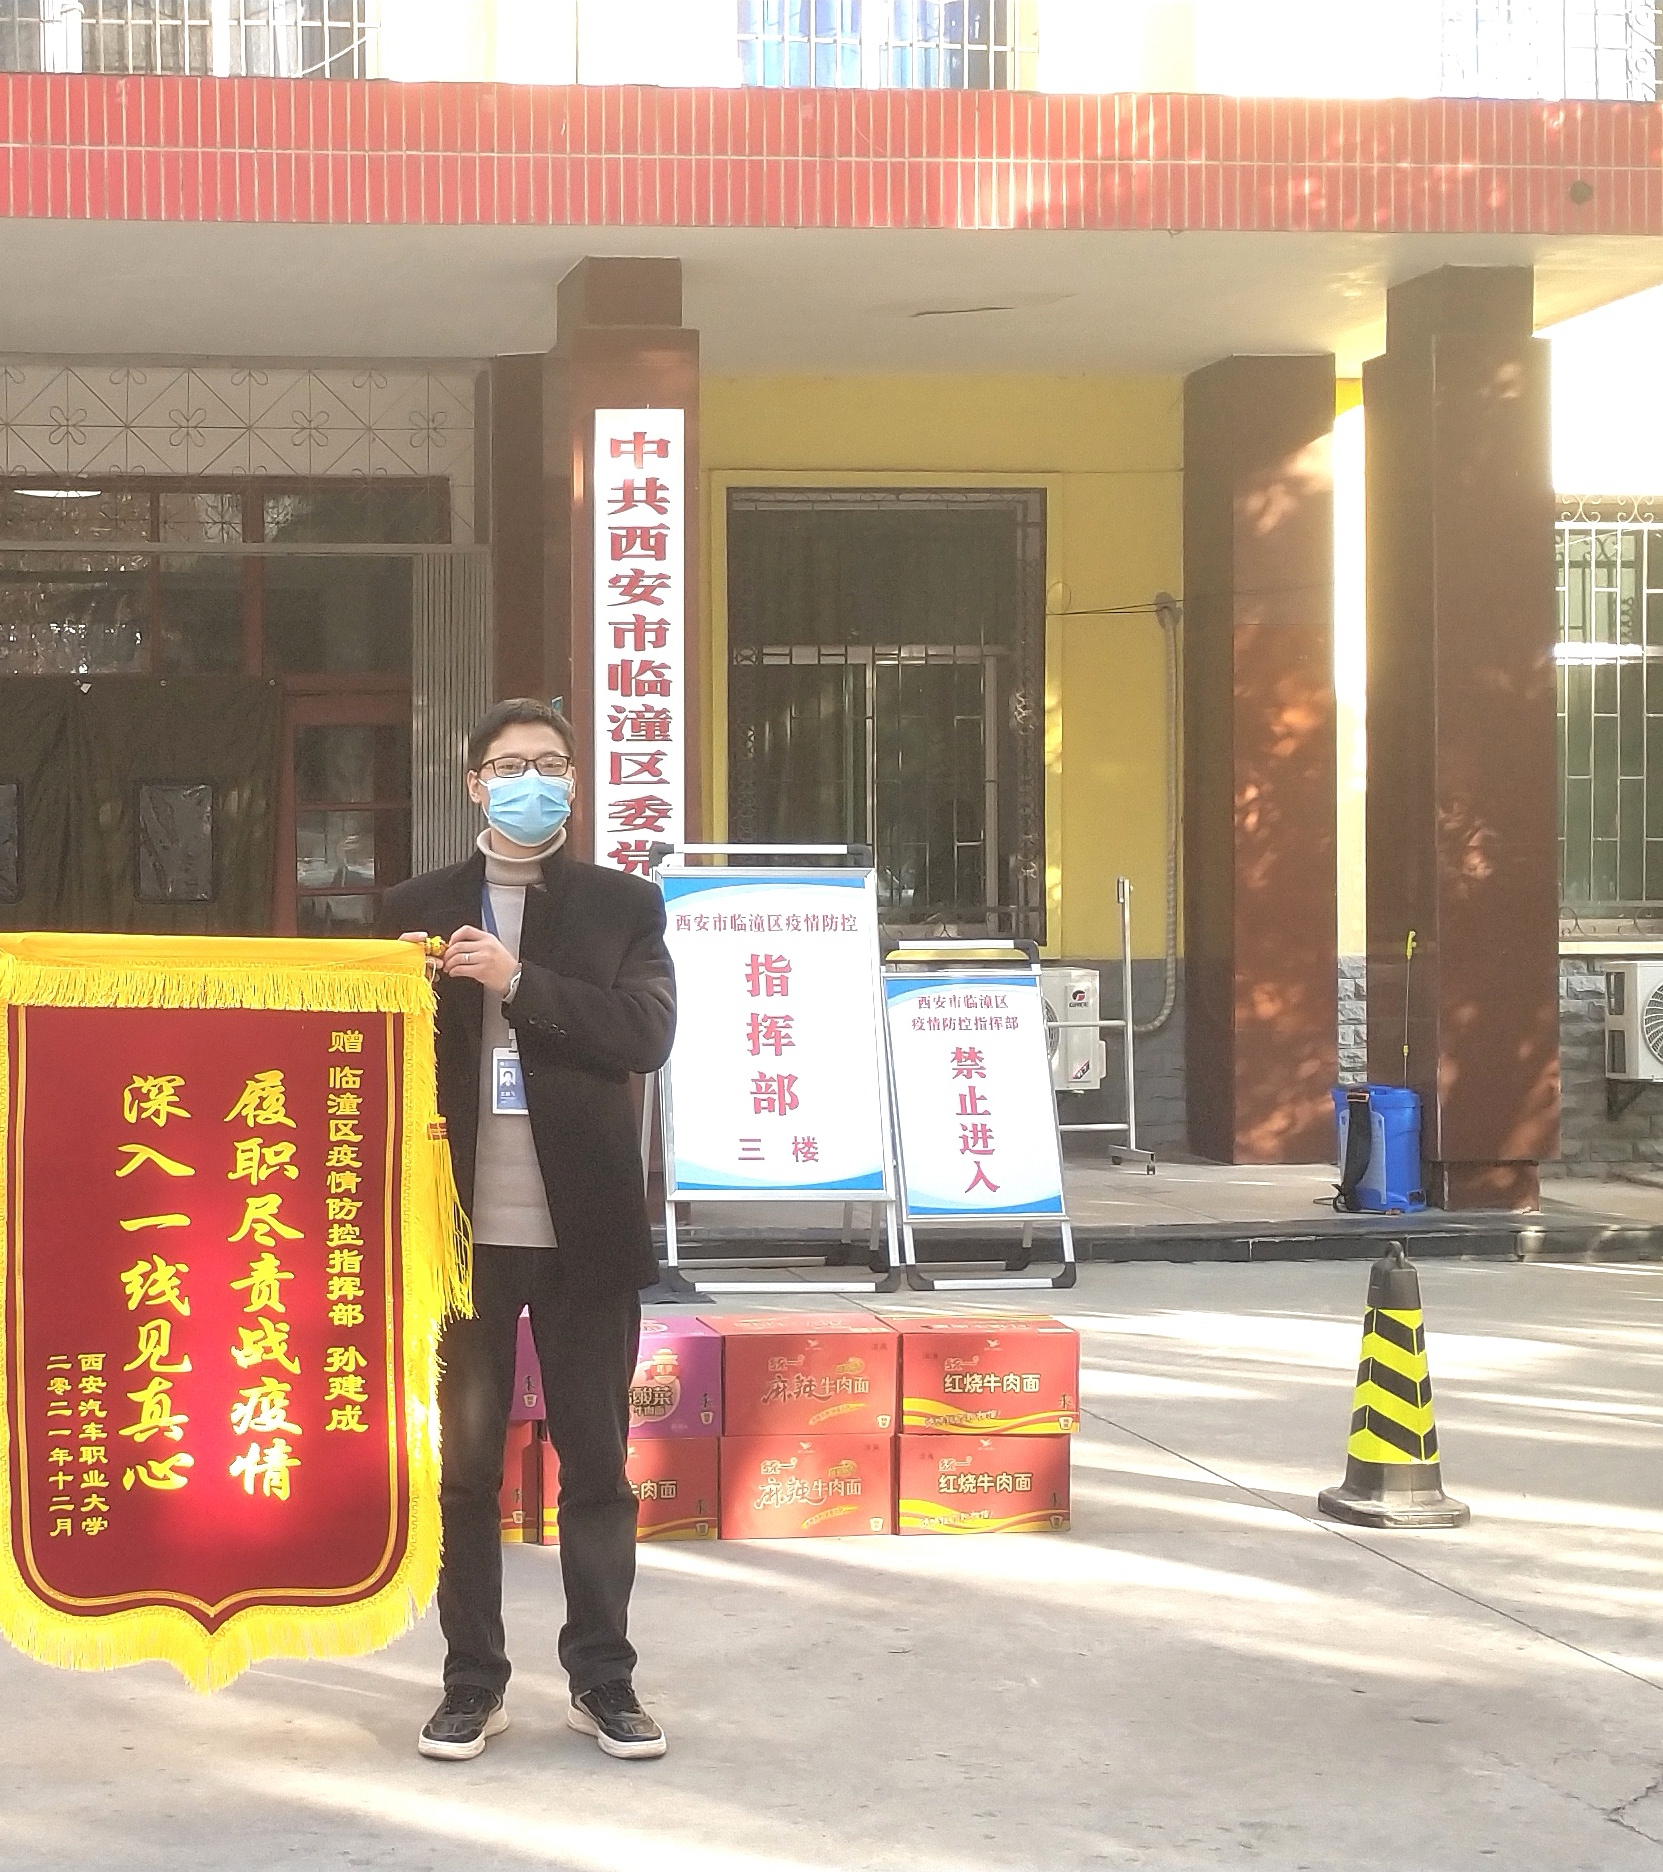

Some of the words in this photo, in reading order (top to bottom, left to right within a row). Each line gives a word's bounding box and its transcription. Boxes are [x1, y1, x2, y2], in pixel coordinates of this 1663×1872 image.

[607, 431, 672, 876] 中共西安市临潼区委党
[675, 913, 859, 934] 西安市临潼区疫情防控
[327, 1029, 364, 1054] 赠
[744, 953, 800, 1118] 指挥部
[911, 1015, 1019, 1032] 疫情防控指挥部
[917, 994, 1009, 1010] 西安市临潼区
[950, 1045, 1001, 1194] 禁止进入
[325, 1065, 365, 1327] 临潼区疫情防控指挥部
[115, 1074, 195, 1492] 深入一线见真心
[223, 1069, 306, 1502] 履职尽责战疫情
[324, 1345, 370, 1434] 孙建成
[629, 1386, 672, 1406] 酸菜
[943, 1373, 1041, 1393] 红烧牛肉面
[46, 1355, 75, 1537] 二零二一年十二月
[77, 1353, 110, 1536] 西安汽车职业大学
[938, 1473, 1033, 1494] 红烧牛肉面
